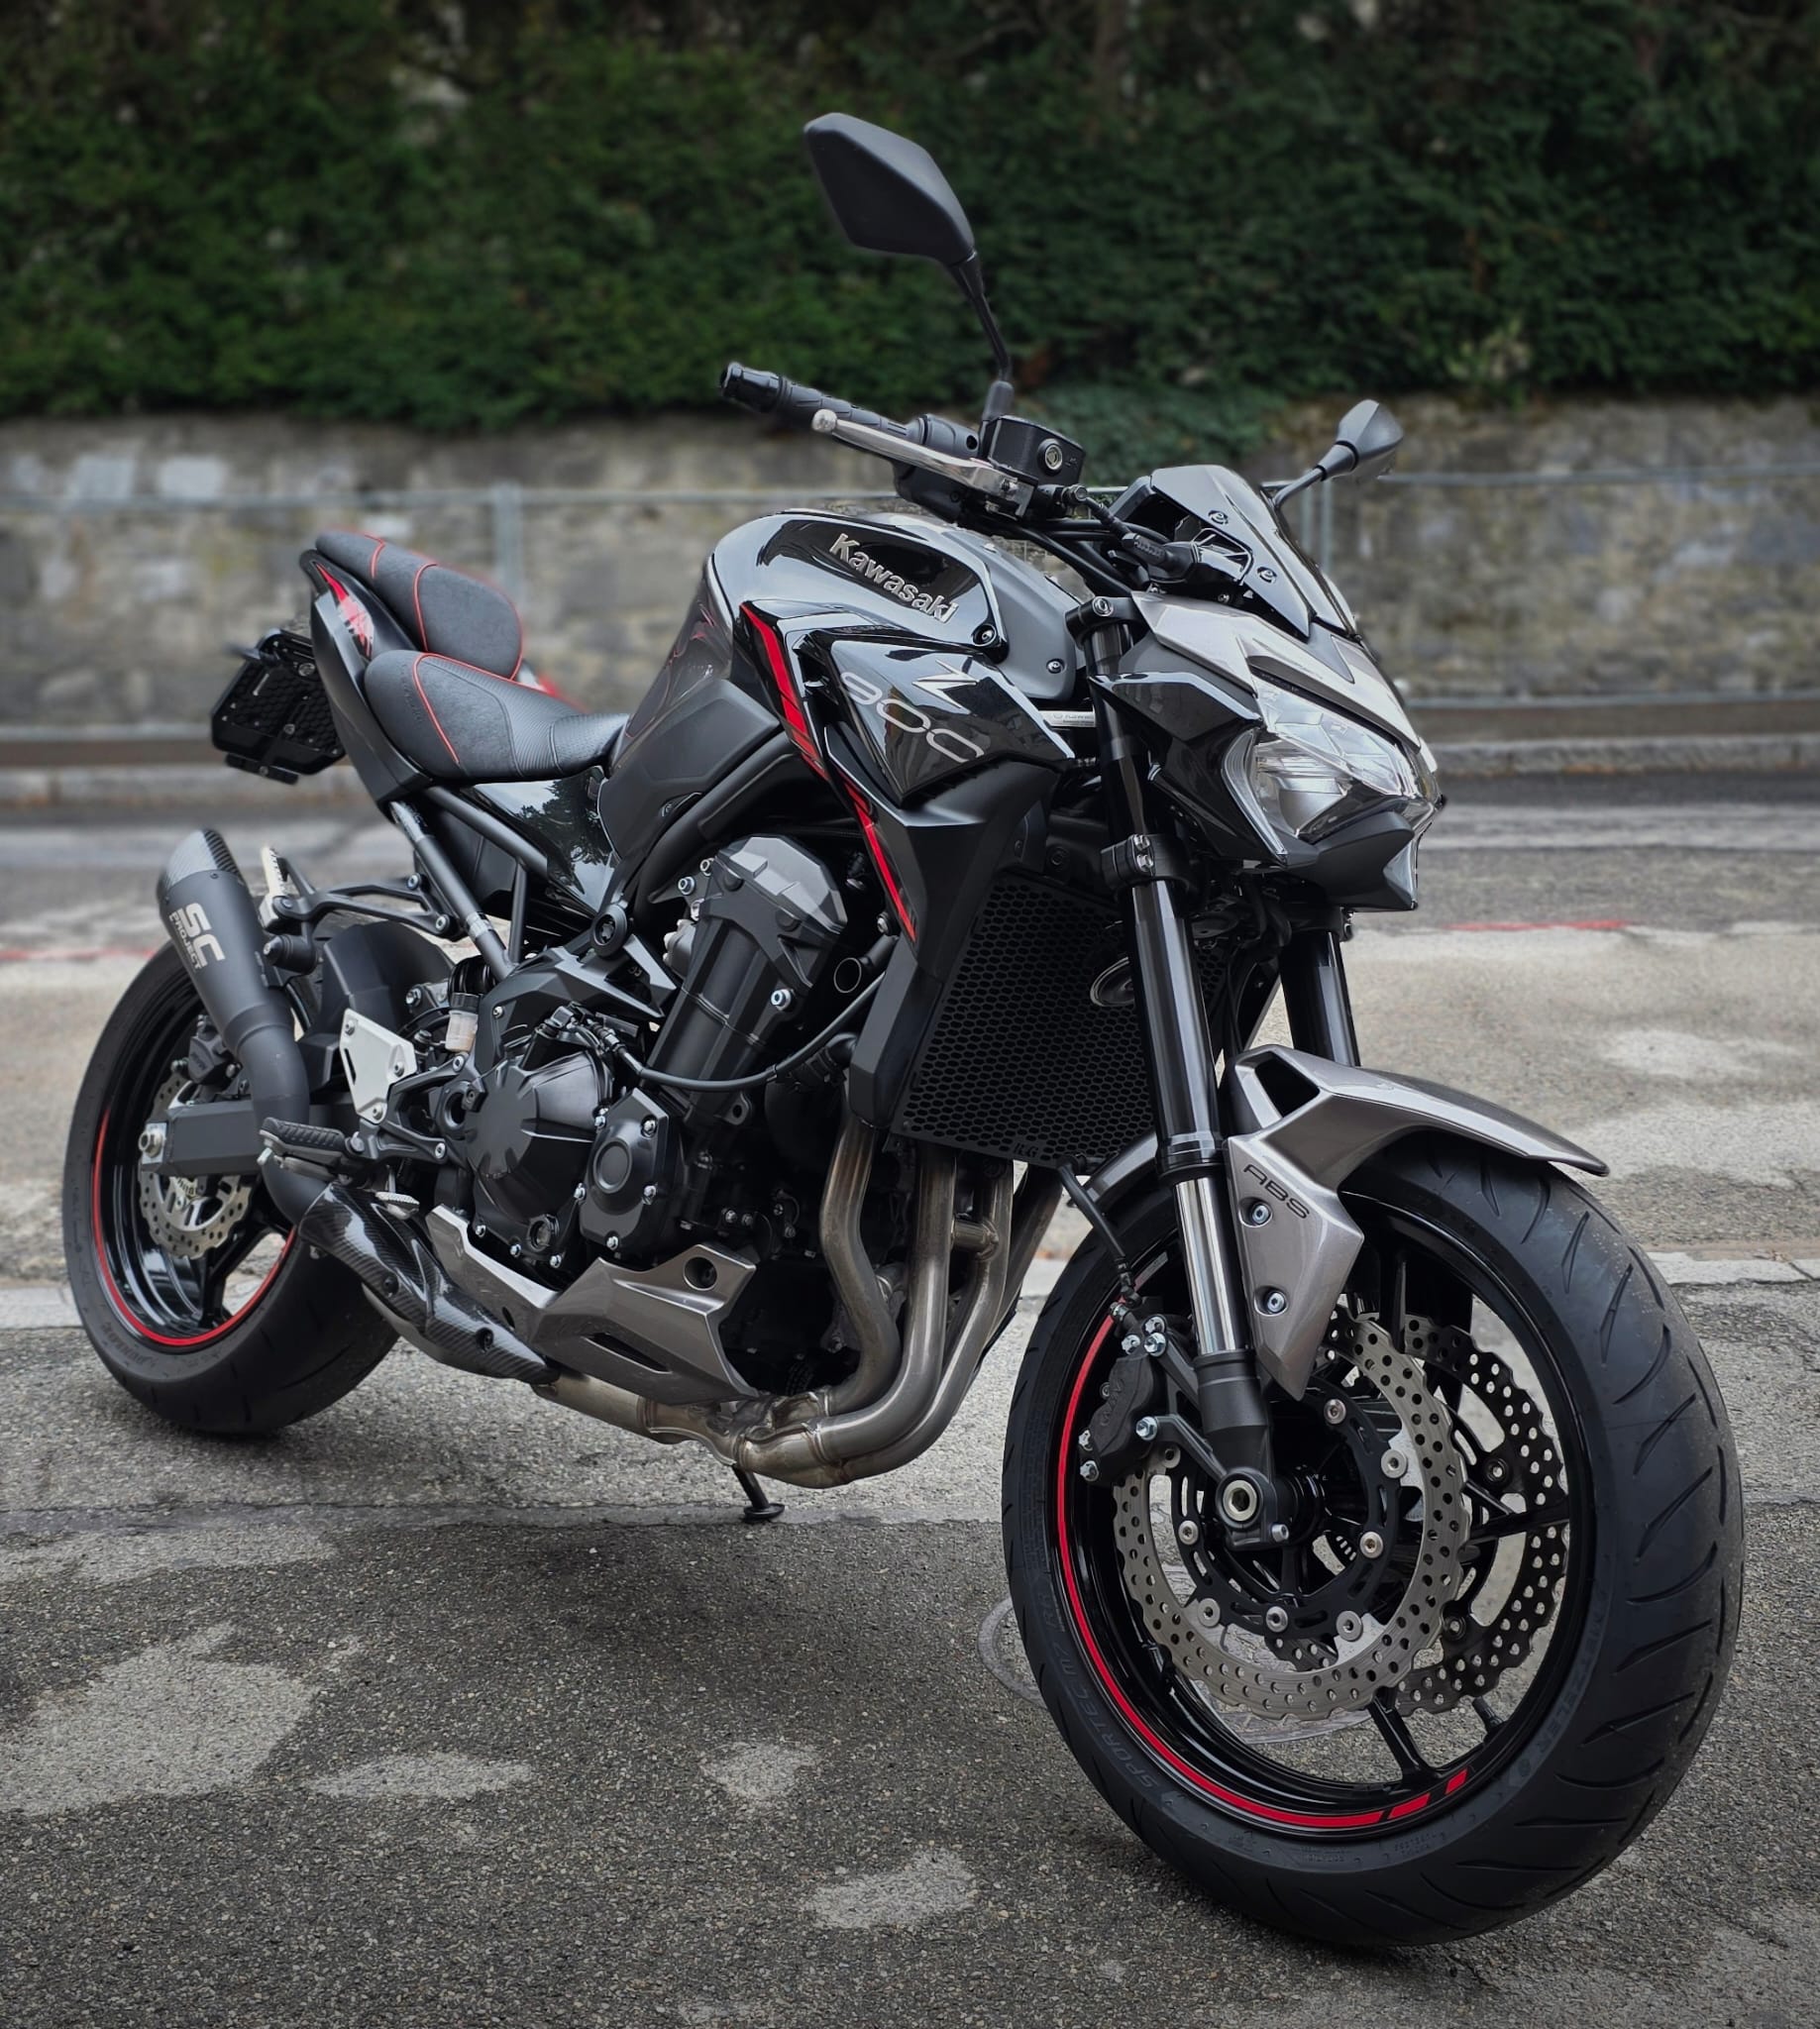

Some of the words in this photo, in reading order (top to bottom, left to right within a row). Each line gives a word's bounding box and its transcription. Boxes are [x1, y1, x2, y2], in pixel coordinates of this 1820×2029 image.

[828, 533, 960, 624] Kawasaki
[841, 671, 985, 763] 900
[169, 911, 203, 970] PROJECT
[1243, 1164, 1310, 1220] ABS
[1069, 1682, 1159, 1788] SPORTEC
